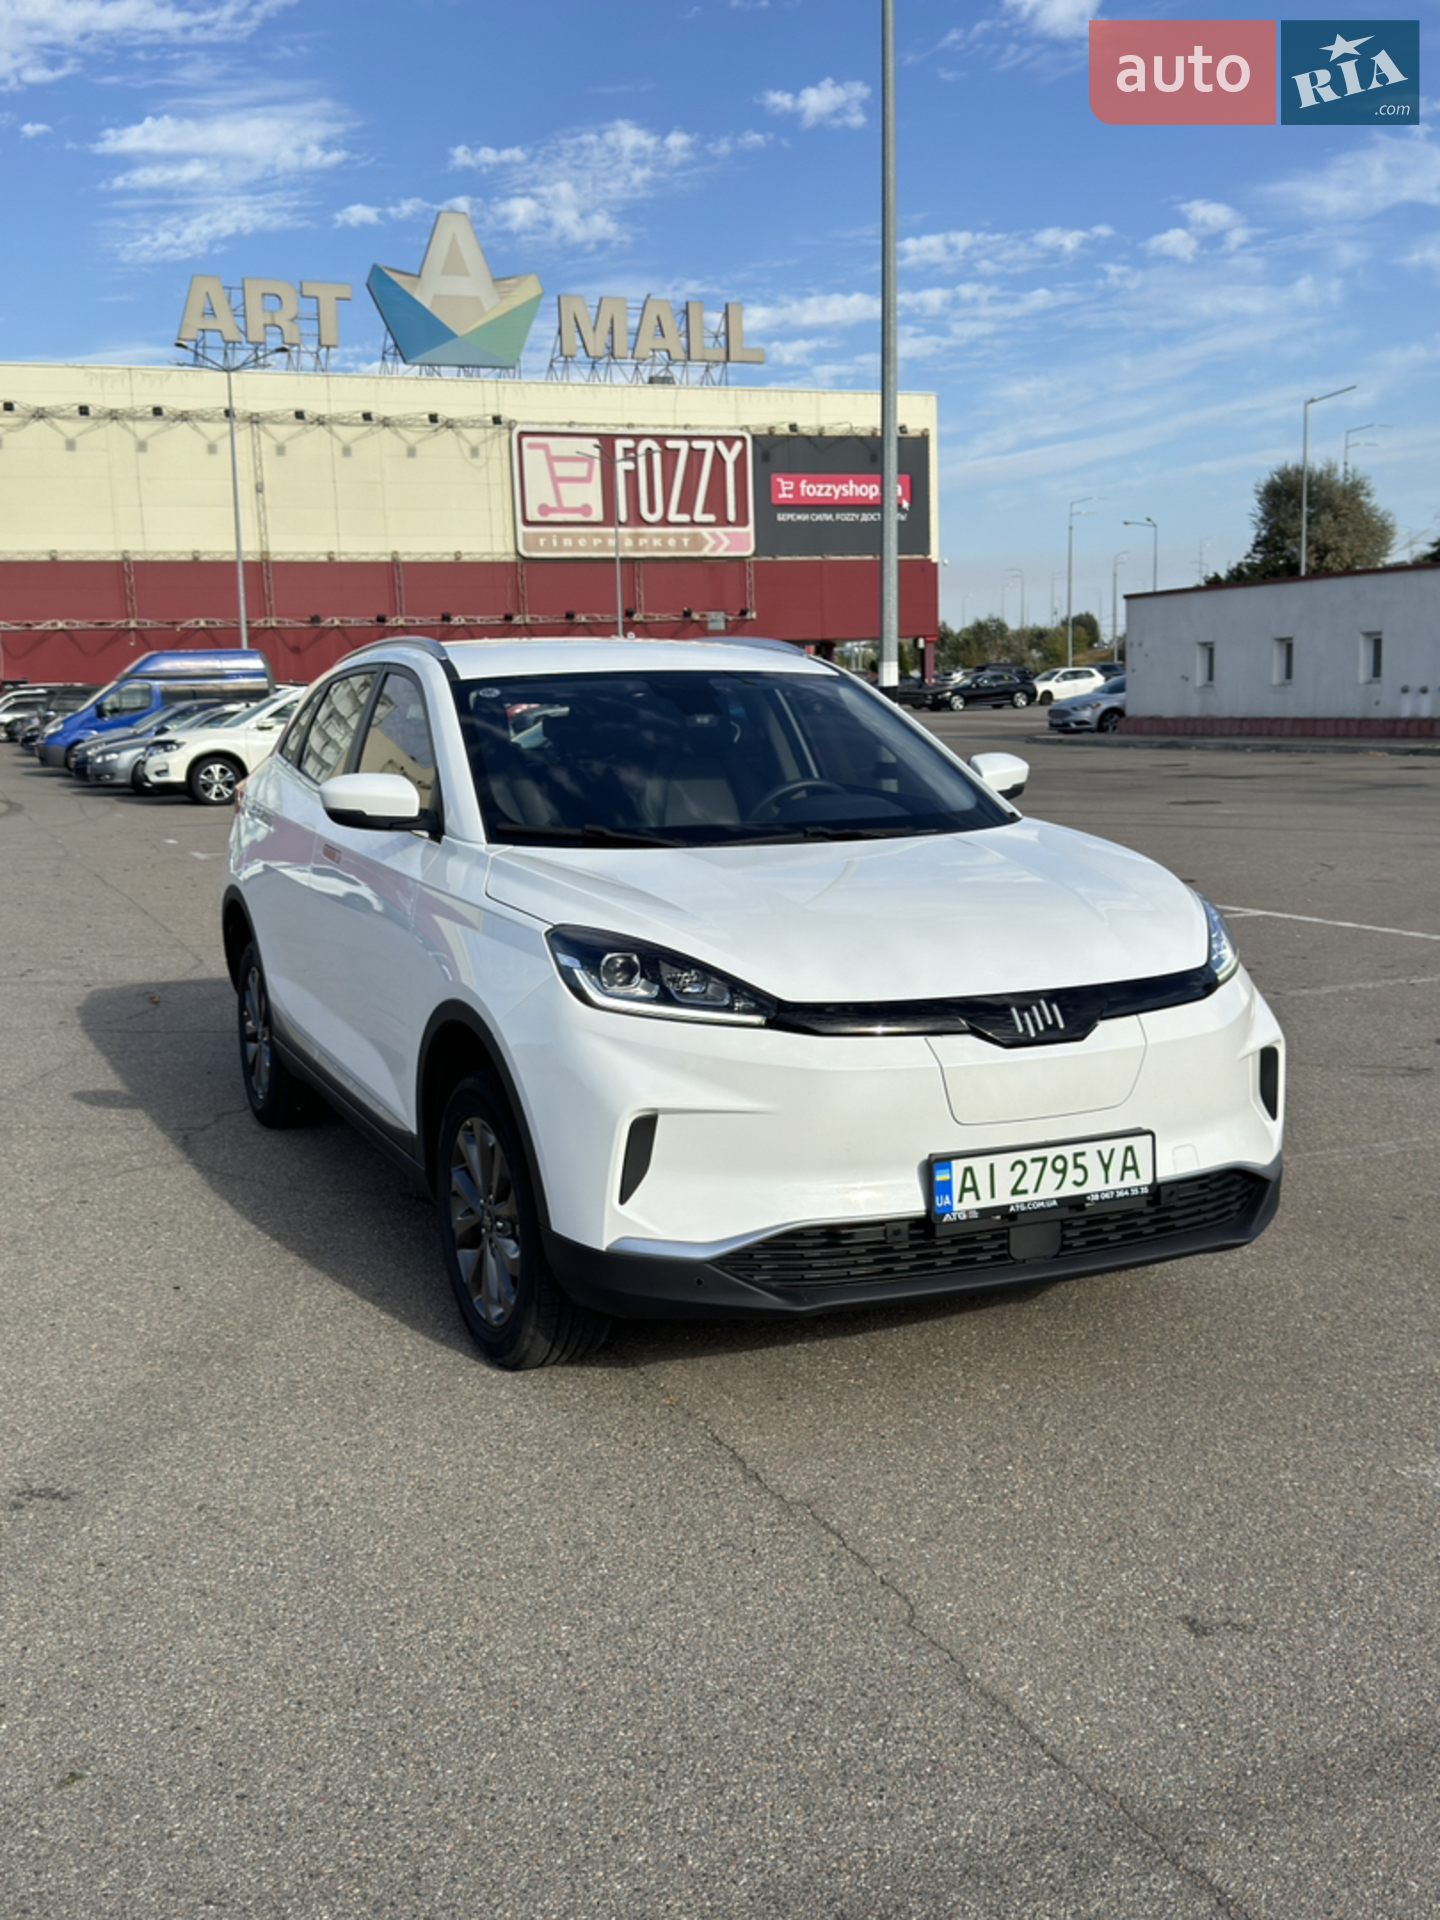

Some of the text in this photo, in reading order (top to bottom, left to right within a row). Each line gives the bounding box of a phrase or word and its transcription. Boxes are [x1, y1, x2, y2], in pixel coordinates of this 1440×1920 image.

[177, 274, 765, 364] ART MALL
[614, 438, 743, 524] FOZZY
[799, 480, 903, 500] fozzyshop.a
[935, 1194, 951, 1207] UA
[958, 1145, 1141, 1204] AI 2795 YA
